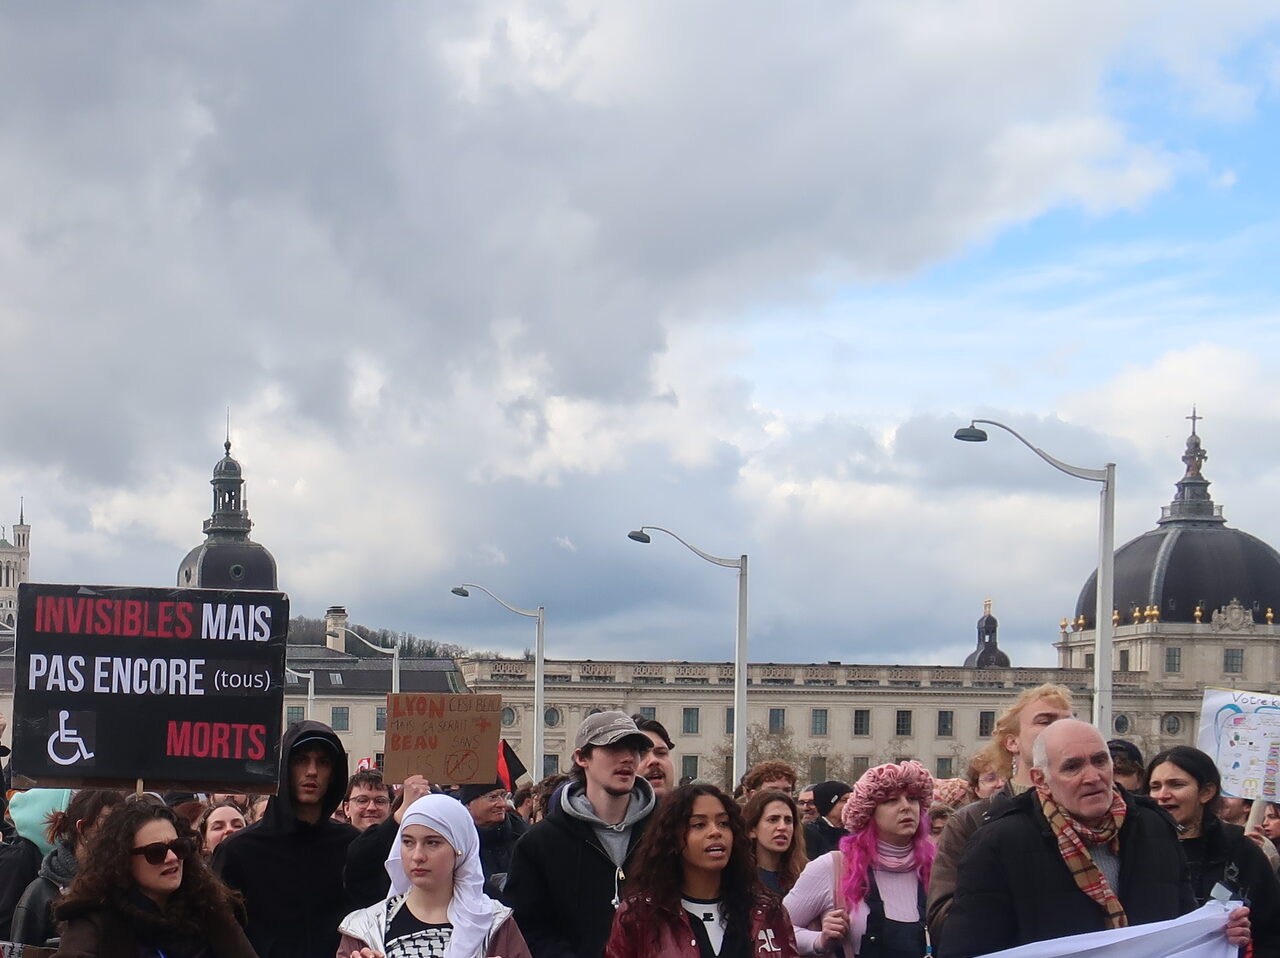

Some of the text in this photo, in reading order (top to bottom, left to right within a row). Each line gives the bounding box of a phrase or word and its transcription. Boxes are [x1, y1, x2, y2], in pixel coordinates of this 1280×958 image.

[35, 596, 272, 642] INVISIBLES MAIS
[28, 654, 271, 695] PAS ENCORE (tous)
[393, 696, 446, 719] LYON
[1232, 693, 1267, 706] Votre
[166, 720, 267, 761] MORTS
[391, 734, 438, 751] BEAU
